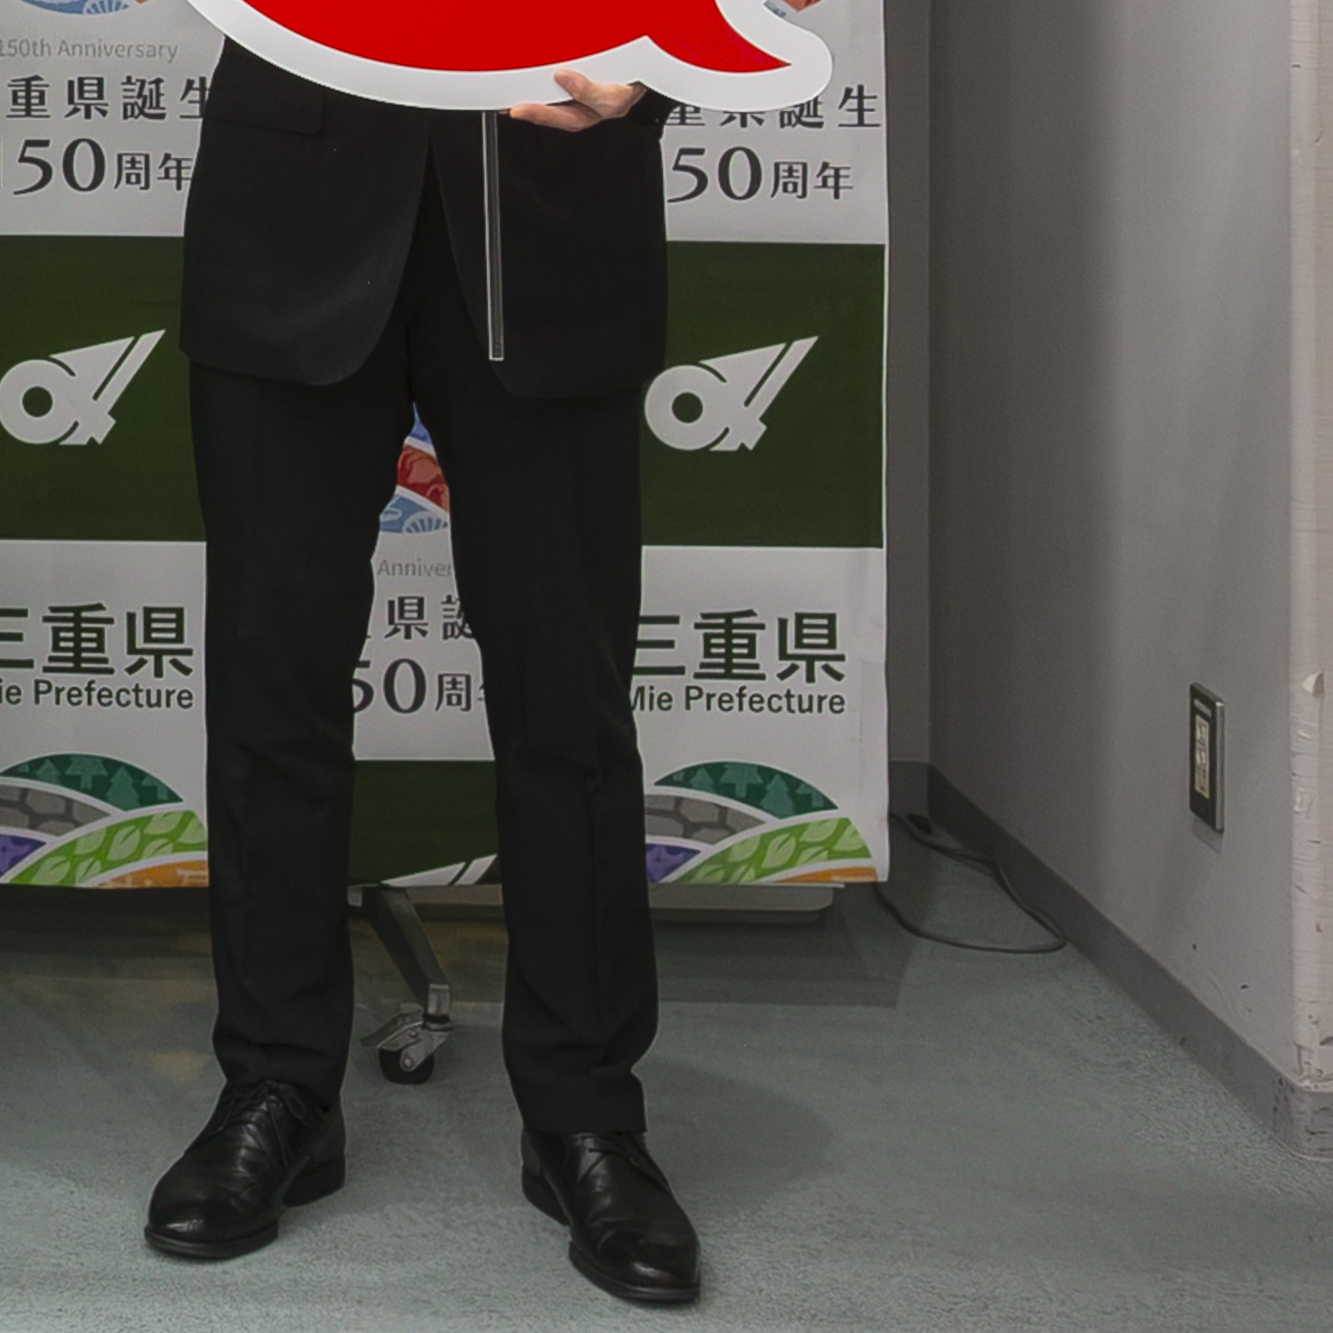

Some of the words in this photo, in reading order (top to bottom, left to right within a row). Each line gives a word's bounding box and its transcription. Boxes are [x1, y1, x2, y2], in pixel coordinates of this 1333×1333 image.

[57, 39, 178, 64] Anniversary
[667, 146, 854, 203] 50周年
[376, 557, 452, 577] Annive
[633, 609, 846, 684] 三重県
[34, 679, 193, 709] Prefecture
[352, 658, 485, 713] 50周
[685, 686, 845, 714] Prefecture
